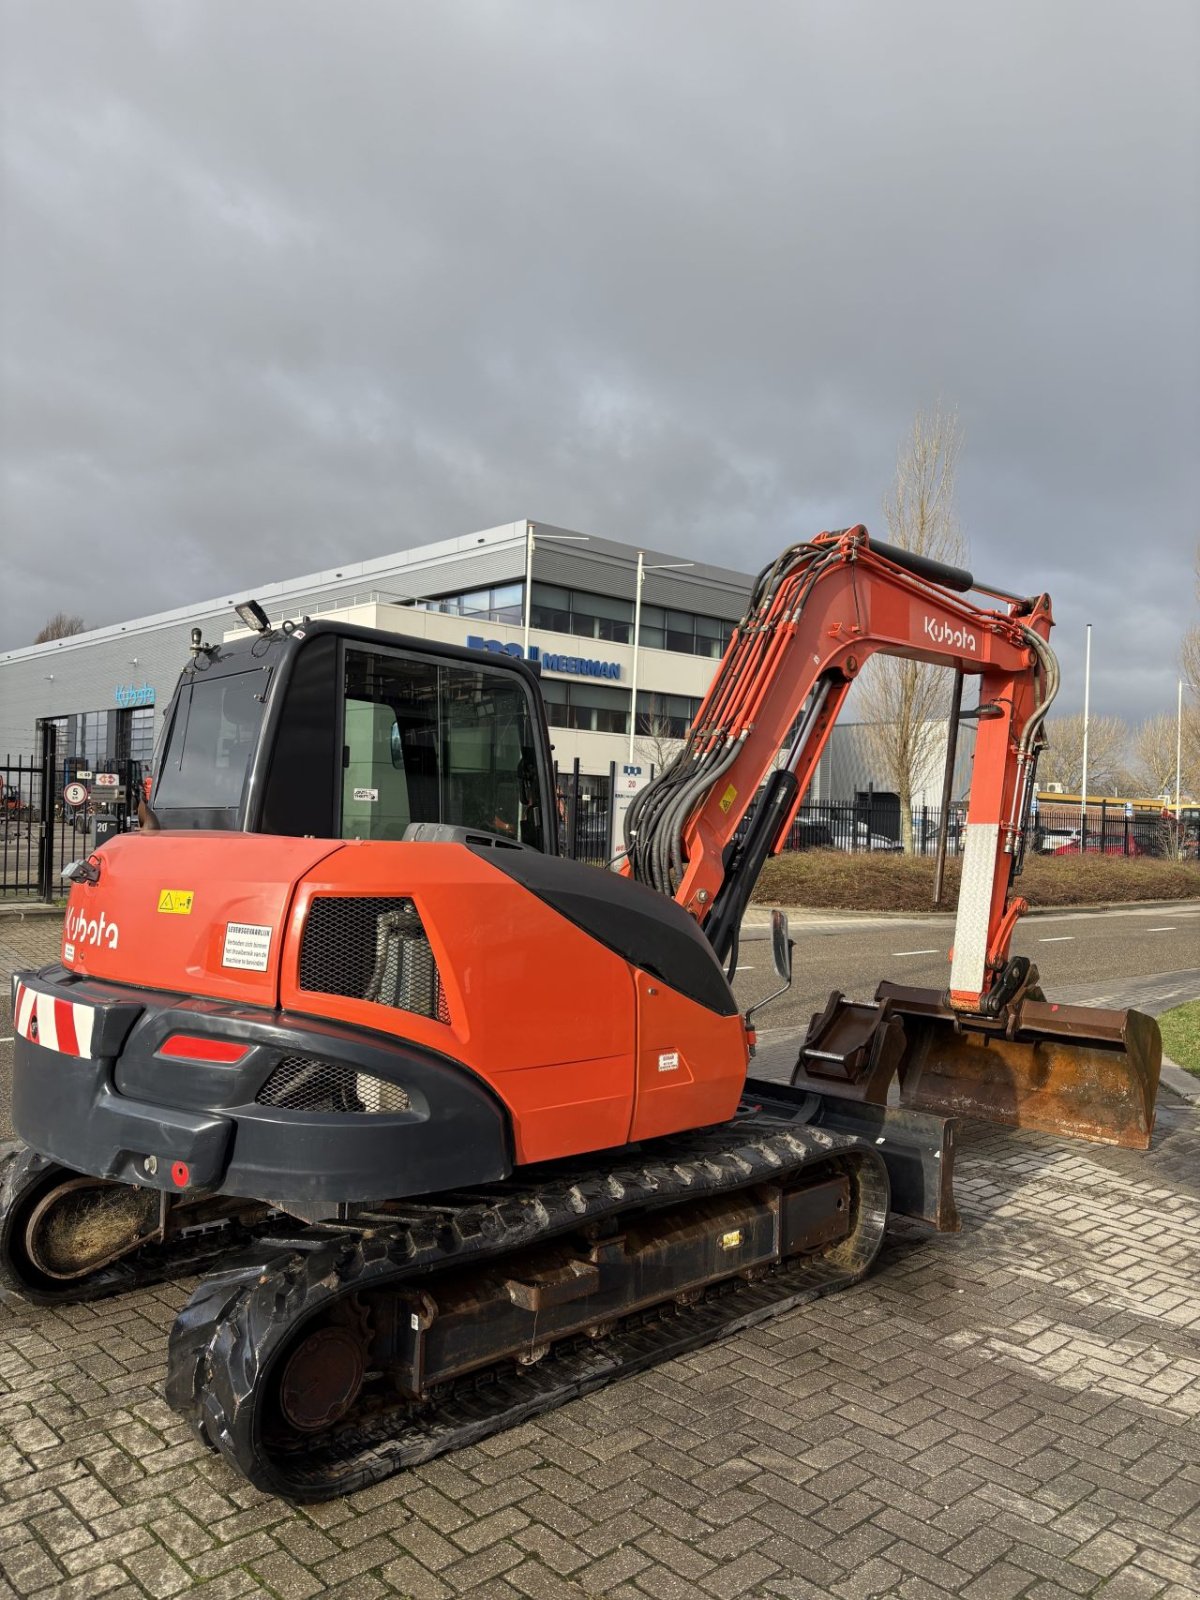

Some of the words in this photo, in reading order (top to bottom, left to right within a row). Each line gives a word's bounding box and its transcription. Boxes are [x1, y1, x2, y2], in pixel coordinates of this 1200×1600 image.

[924, 615, 976, 652] Kubota
[542, 652, 621, 680] MEERMAN
[115, 682, 155, 708] Kubota
[628, 780, 637, 788] 20
[97, 822, 108, 832] 20
[65, 905, 119, 949] Kubota
